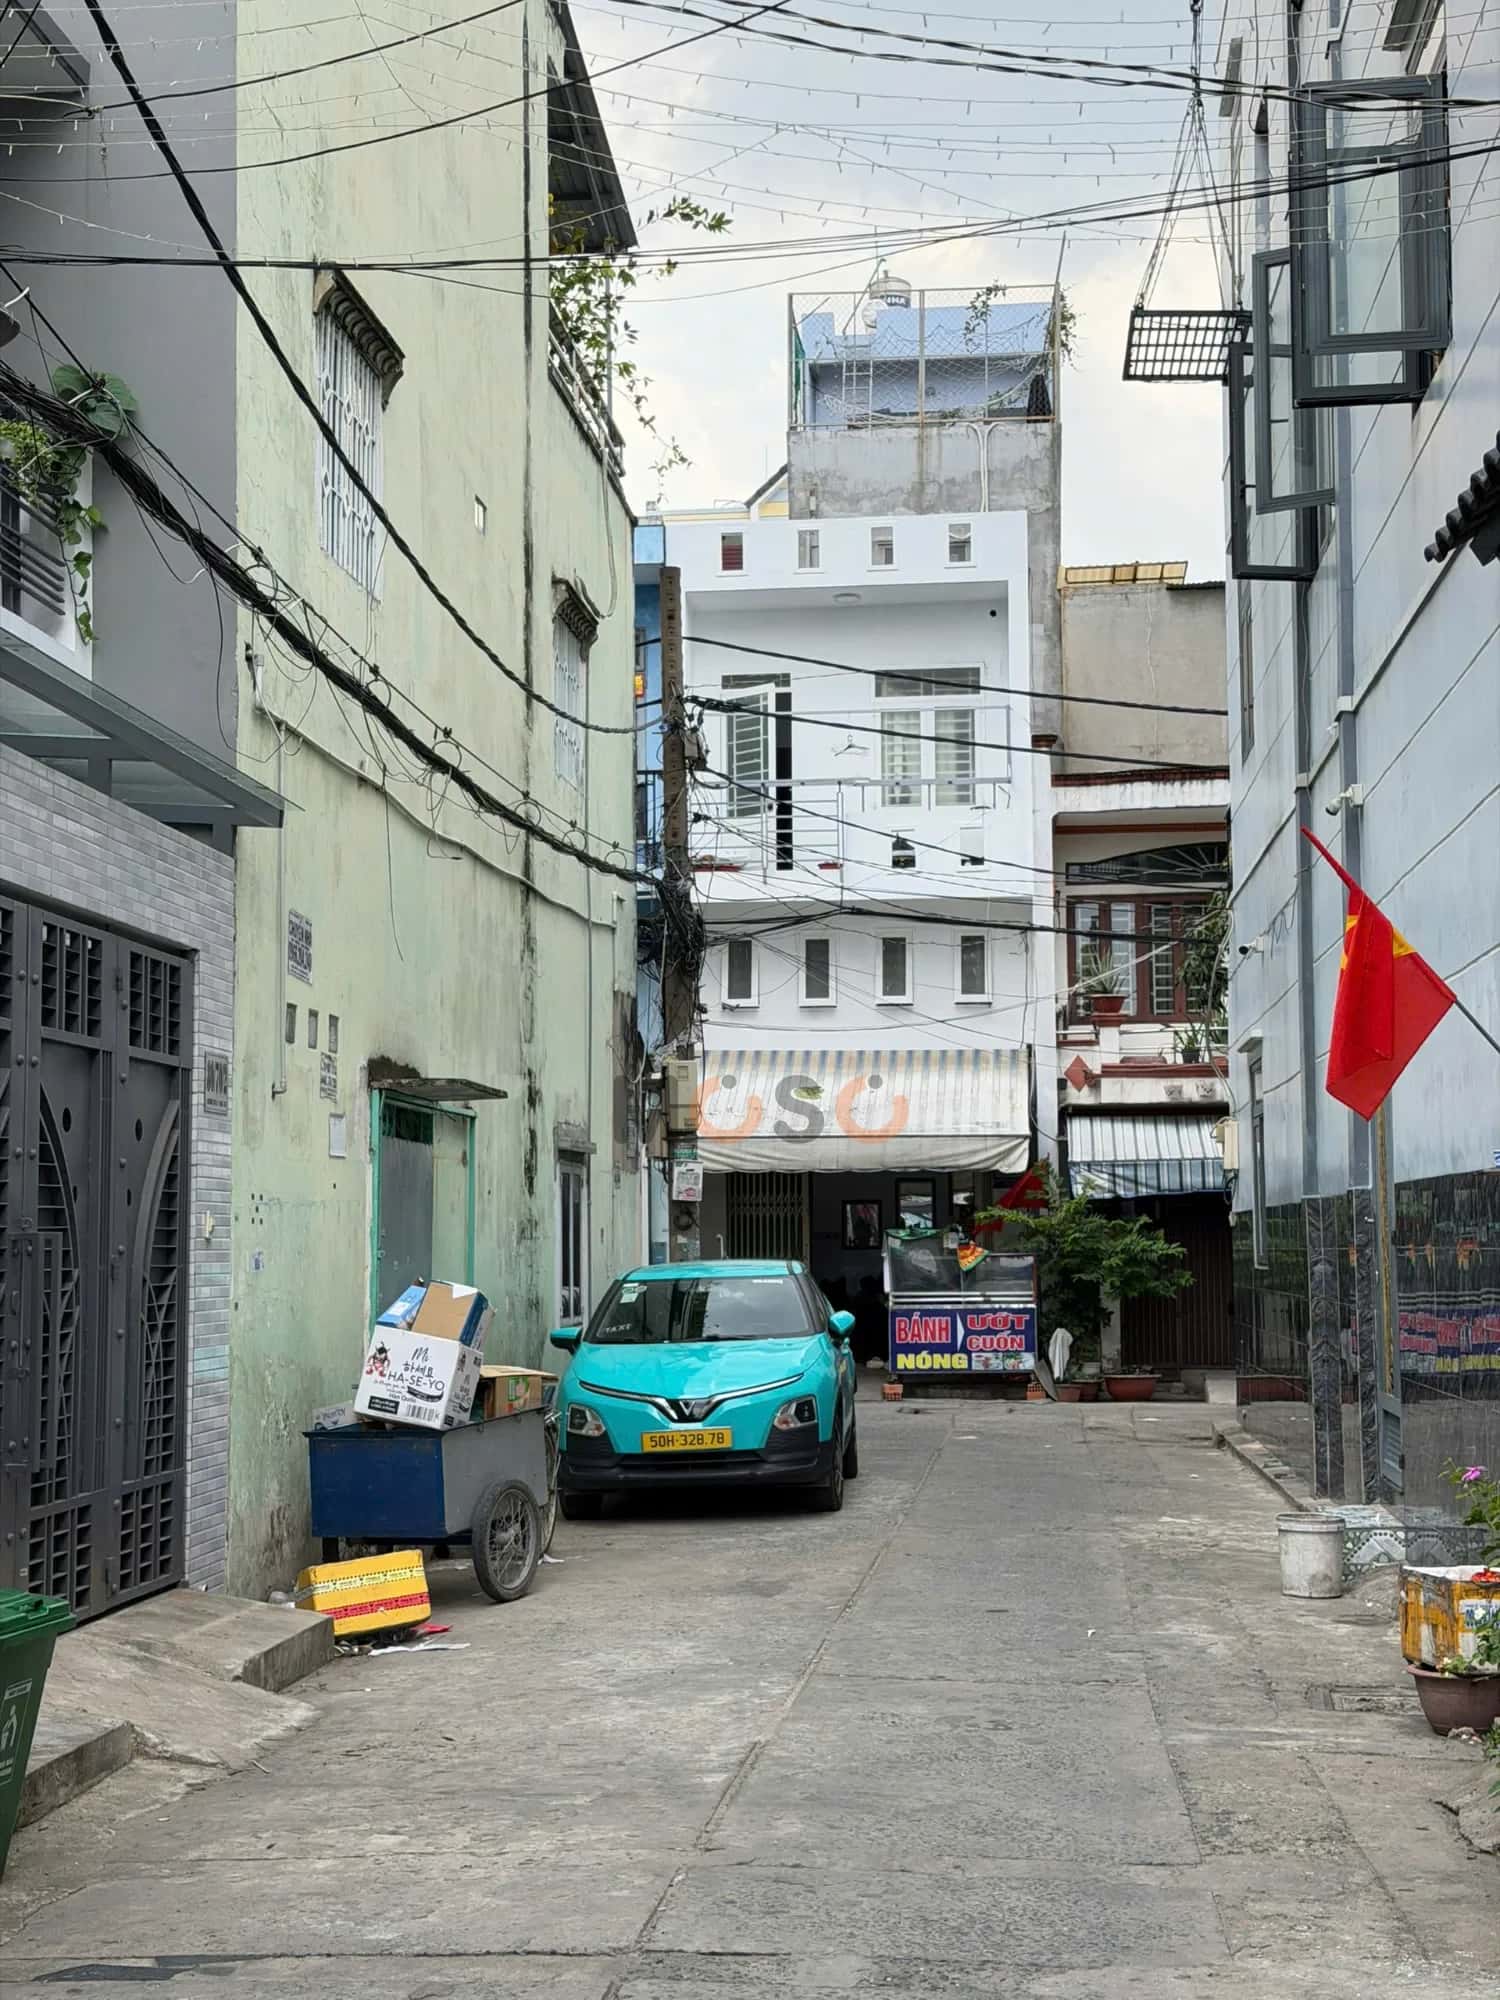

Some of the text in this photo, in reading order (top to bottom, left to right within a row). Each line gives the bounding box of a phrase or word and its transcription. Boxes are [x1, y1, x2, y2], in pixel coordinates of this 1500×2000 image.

[896, 1312, 1029, 1344] BÁNH ƯỚT
[967, 1331, 1025, 1351] CUỐN
[897, 1350, 968, 1370] NÓNG
[388, 1372, 445, 1391] HA-SE-YO
